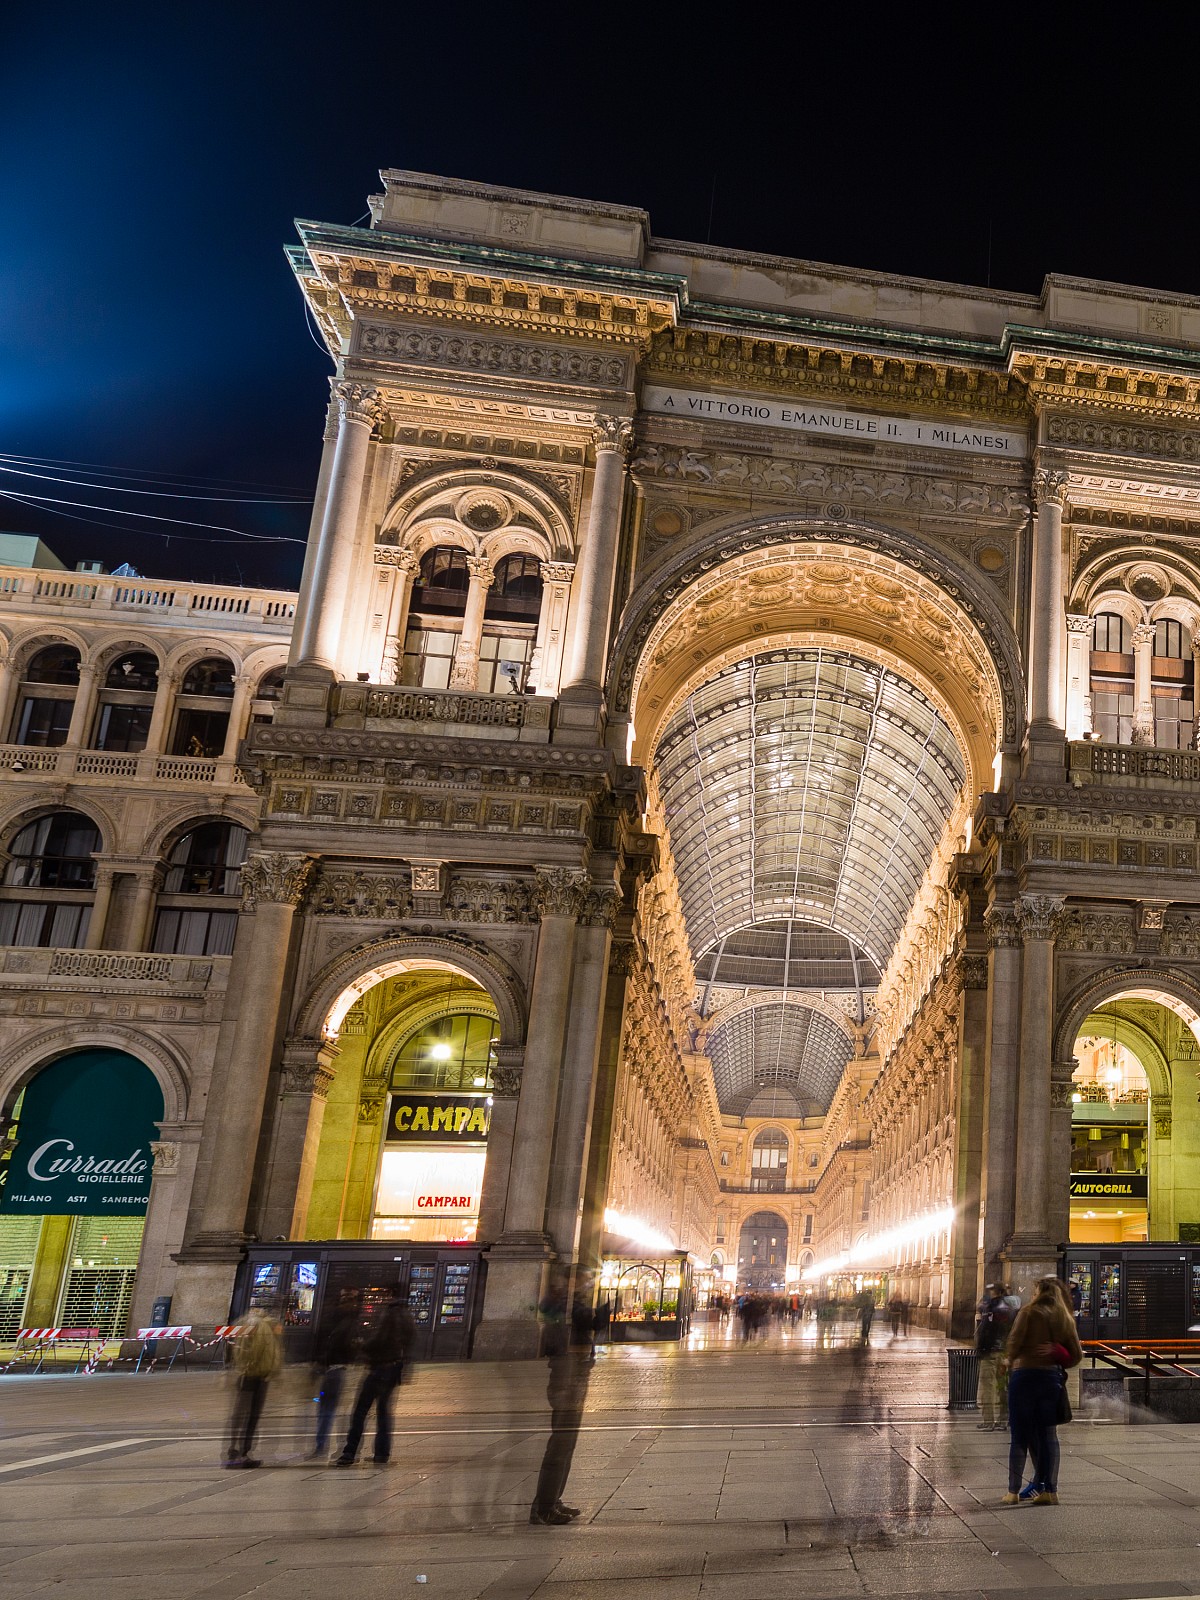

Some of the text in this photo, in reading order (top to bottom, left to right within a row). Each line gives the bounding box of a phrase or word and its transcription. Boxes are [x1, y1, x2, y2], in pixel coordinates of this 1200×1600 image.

[664, 395, 675, 407] A
[688, 397, 770, 419] VITTORIO
[781, 410, 877, 433] EMANUELE
[887, 423, 902, 436] II.
[932, 429, 1009, 450] MILANESI
[395, 1105, 492, 1132] CAMPA
[27, 1138, 148, 1182] Currado
[77, 1174, 145, 1183] GIOIELLERIE
[1074, 1184, 1132, 1194] AUTOGRILL
[10, 1194, 149, 1204] MILANO ASTI SANREMO
[417, 1195, 471, 1208] CAMPARI
